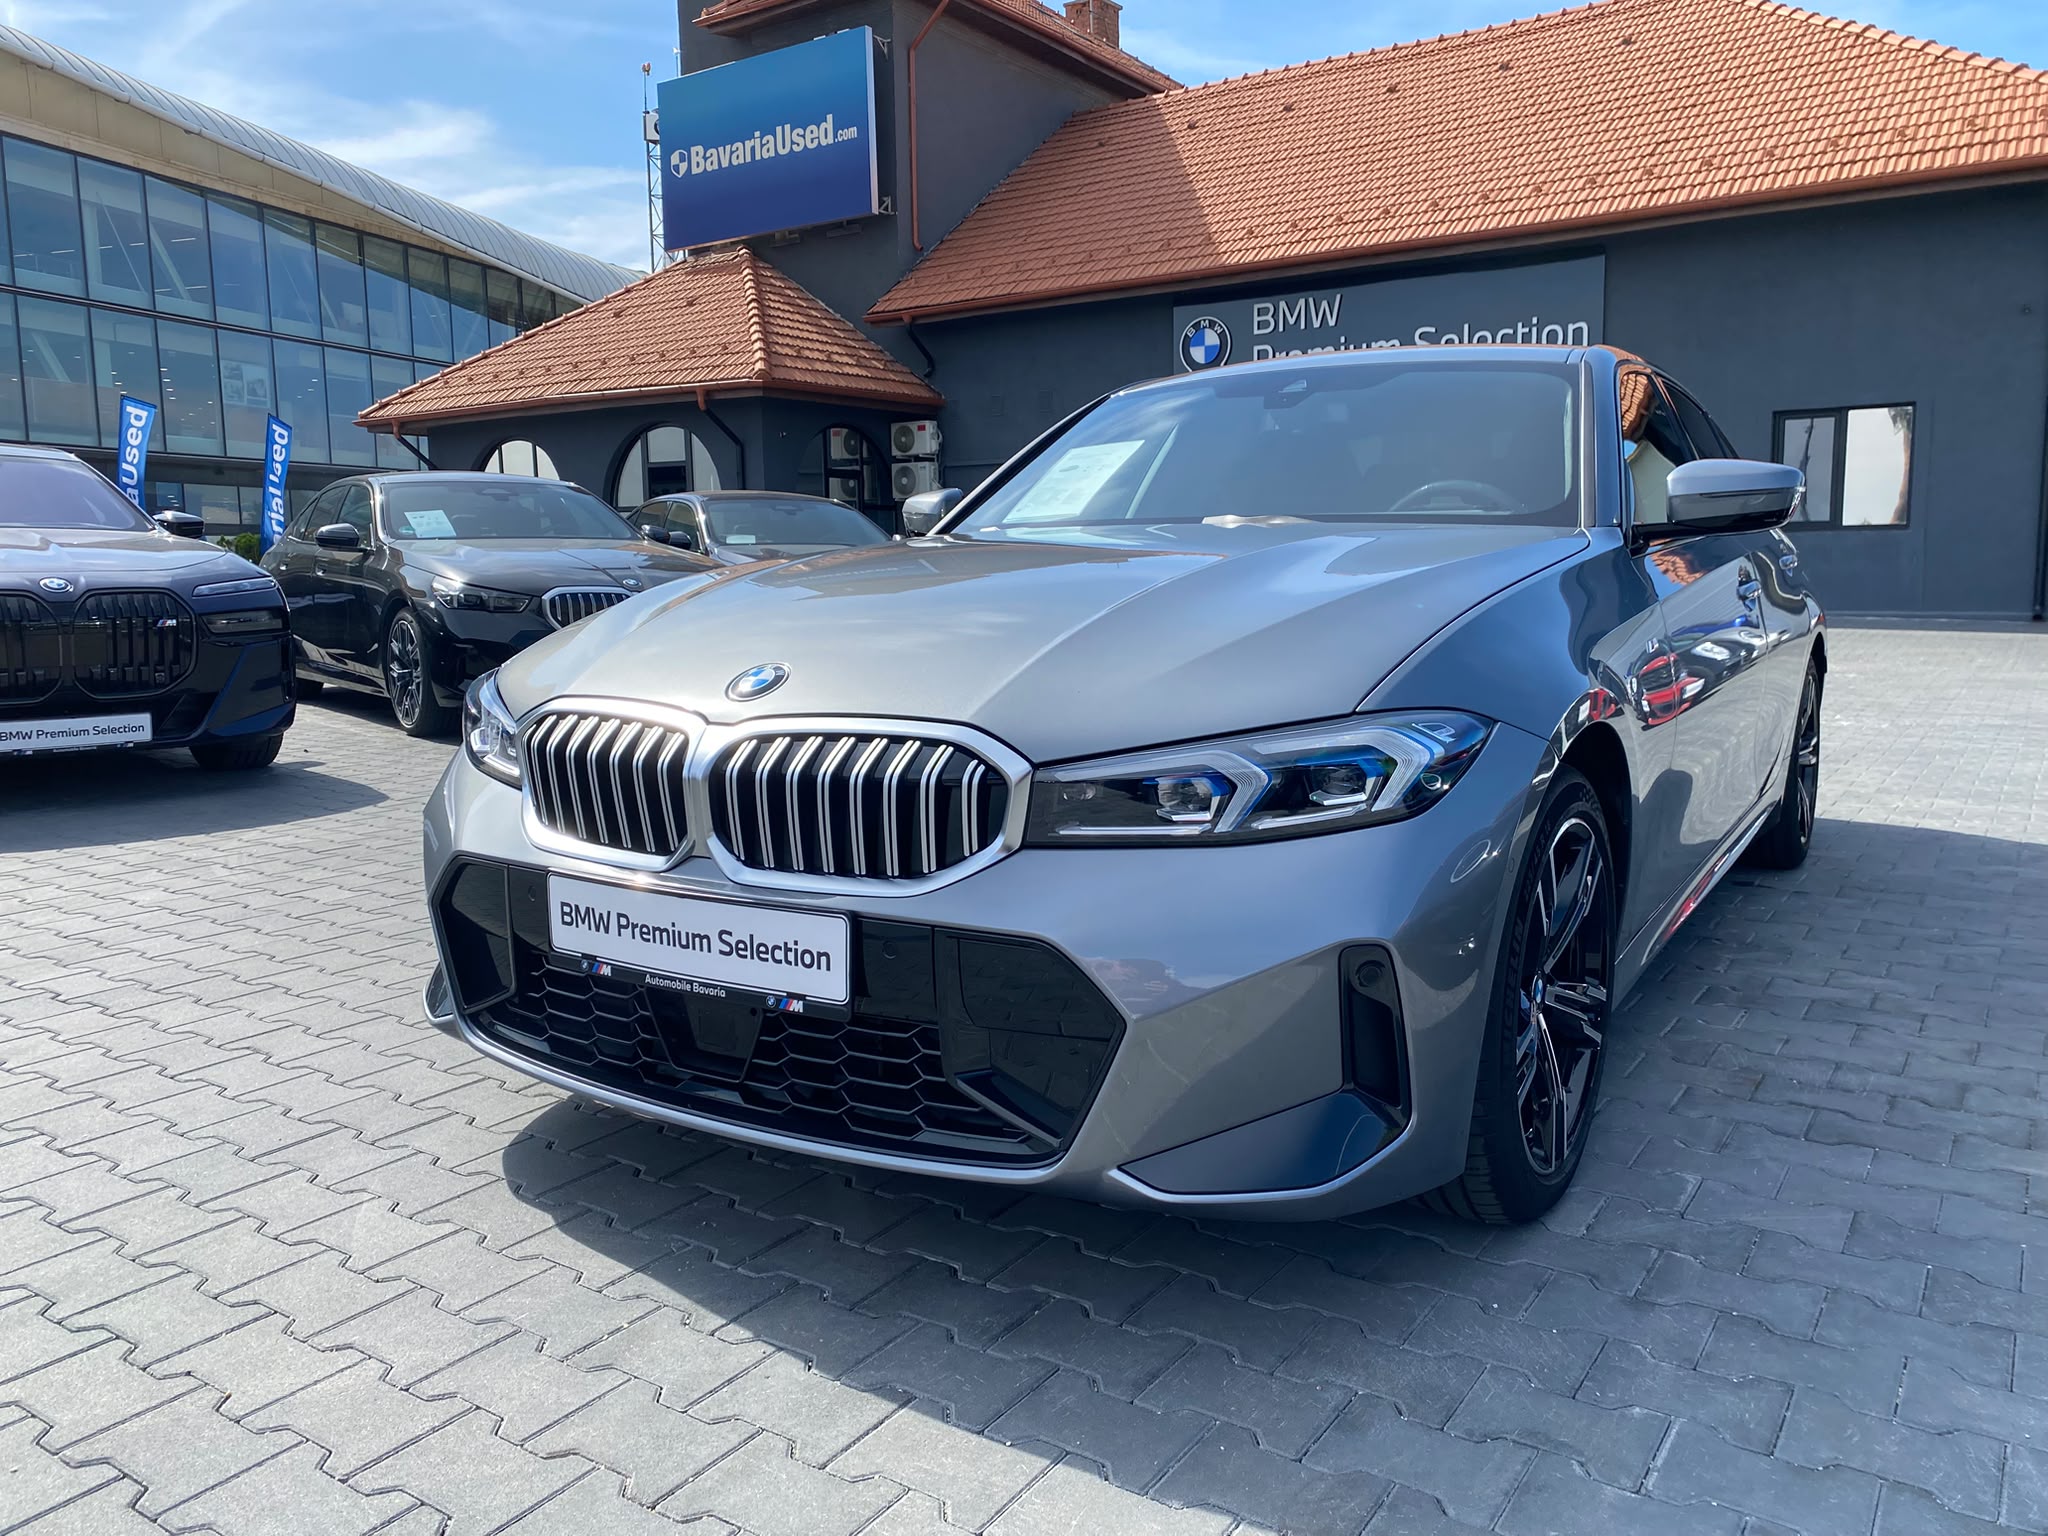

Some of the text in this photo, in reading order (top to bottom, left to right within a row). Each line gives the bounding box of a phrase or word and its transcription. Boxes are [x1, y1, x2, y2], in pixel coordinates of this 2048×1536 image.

[690, 113, 858, 175] BavariaUsed.com
[1253, 293, 1342, 336] BMW
[0, 723, 145, 742] BMW Premium Selection
[560, 900, 832, 972] BMW Premium Selection
[645, 974, 726, 998] Automobile Bavaria
[1503, 917, 1524, 1066] ICHELIN
